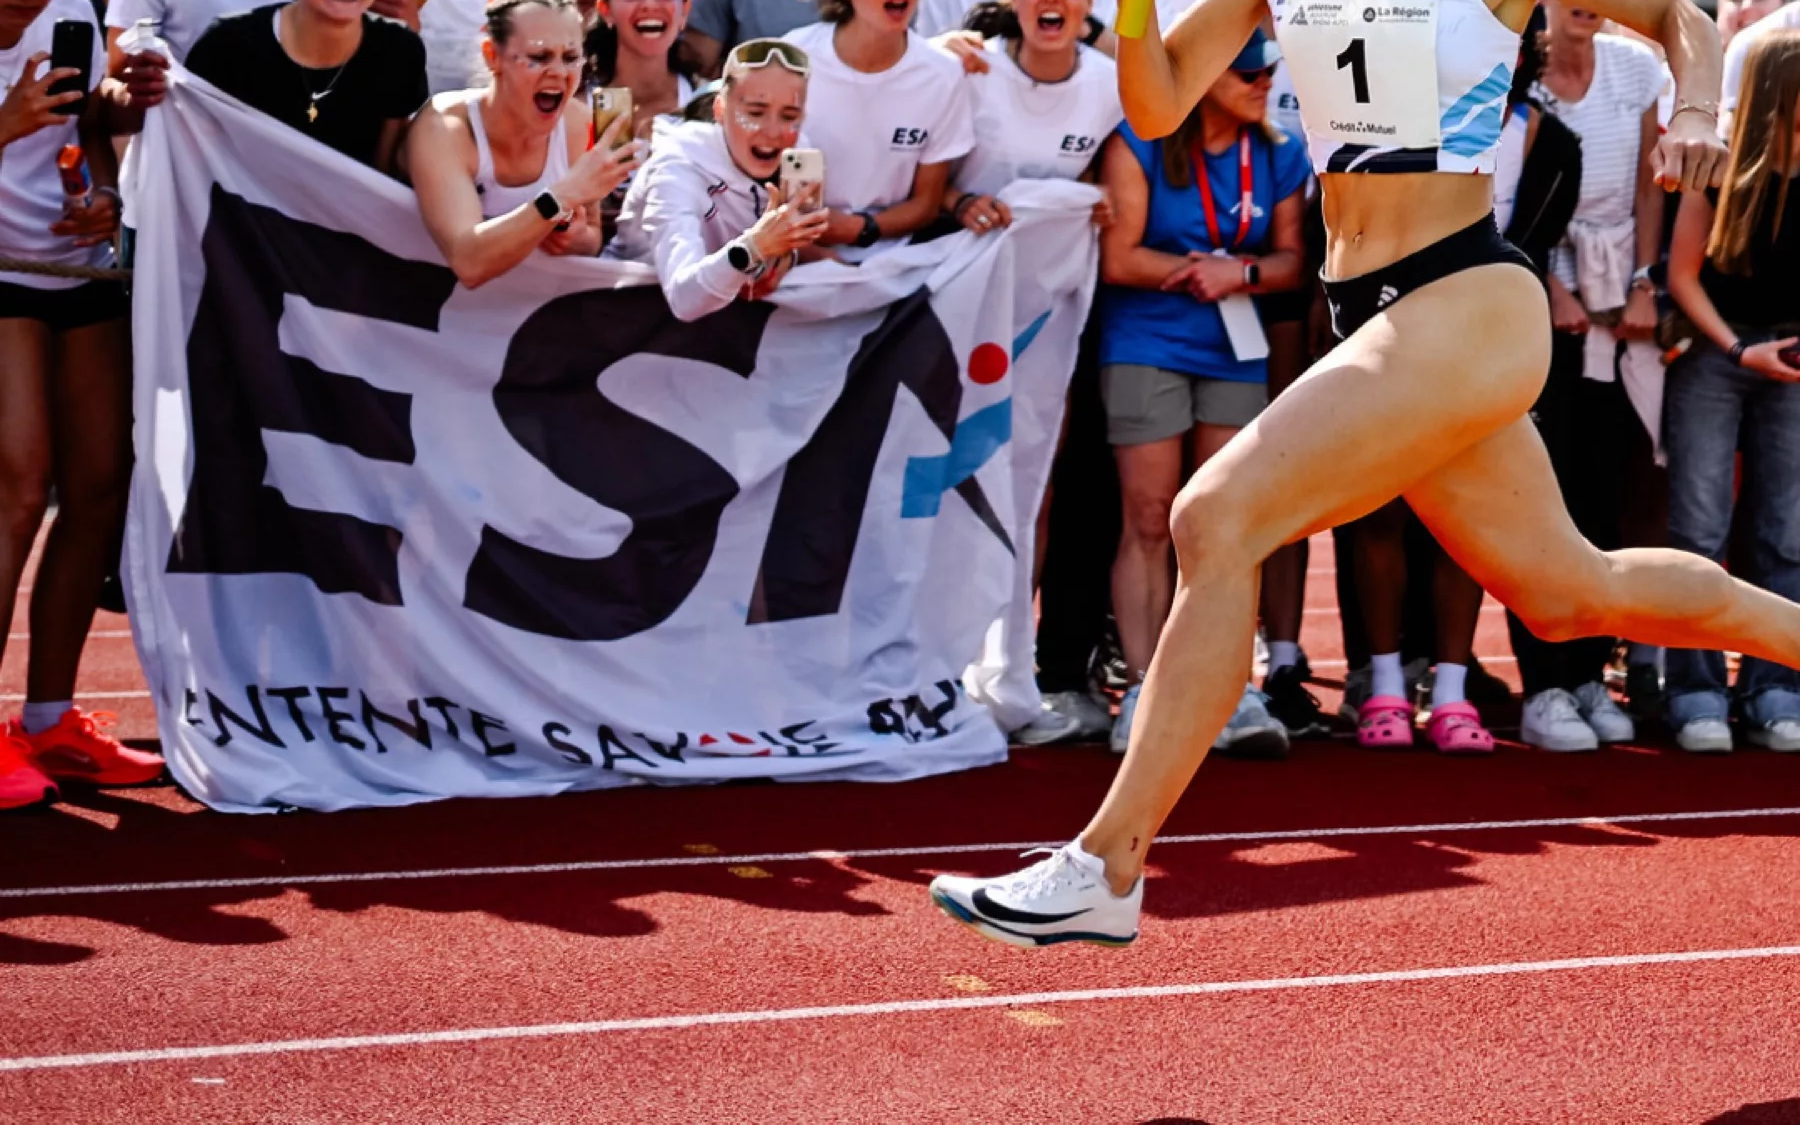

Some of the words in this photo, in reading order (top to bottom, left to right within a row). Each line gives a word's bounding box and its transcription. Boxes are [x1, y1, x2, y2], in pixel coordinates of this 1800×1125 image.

[1378, 6, 1391, 16] La
[1336, 38, 1371, 104] 1
[1277, 92, 1300, 110] ES
[165, 181, 1016, 642] ESA
